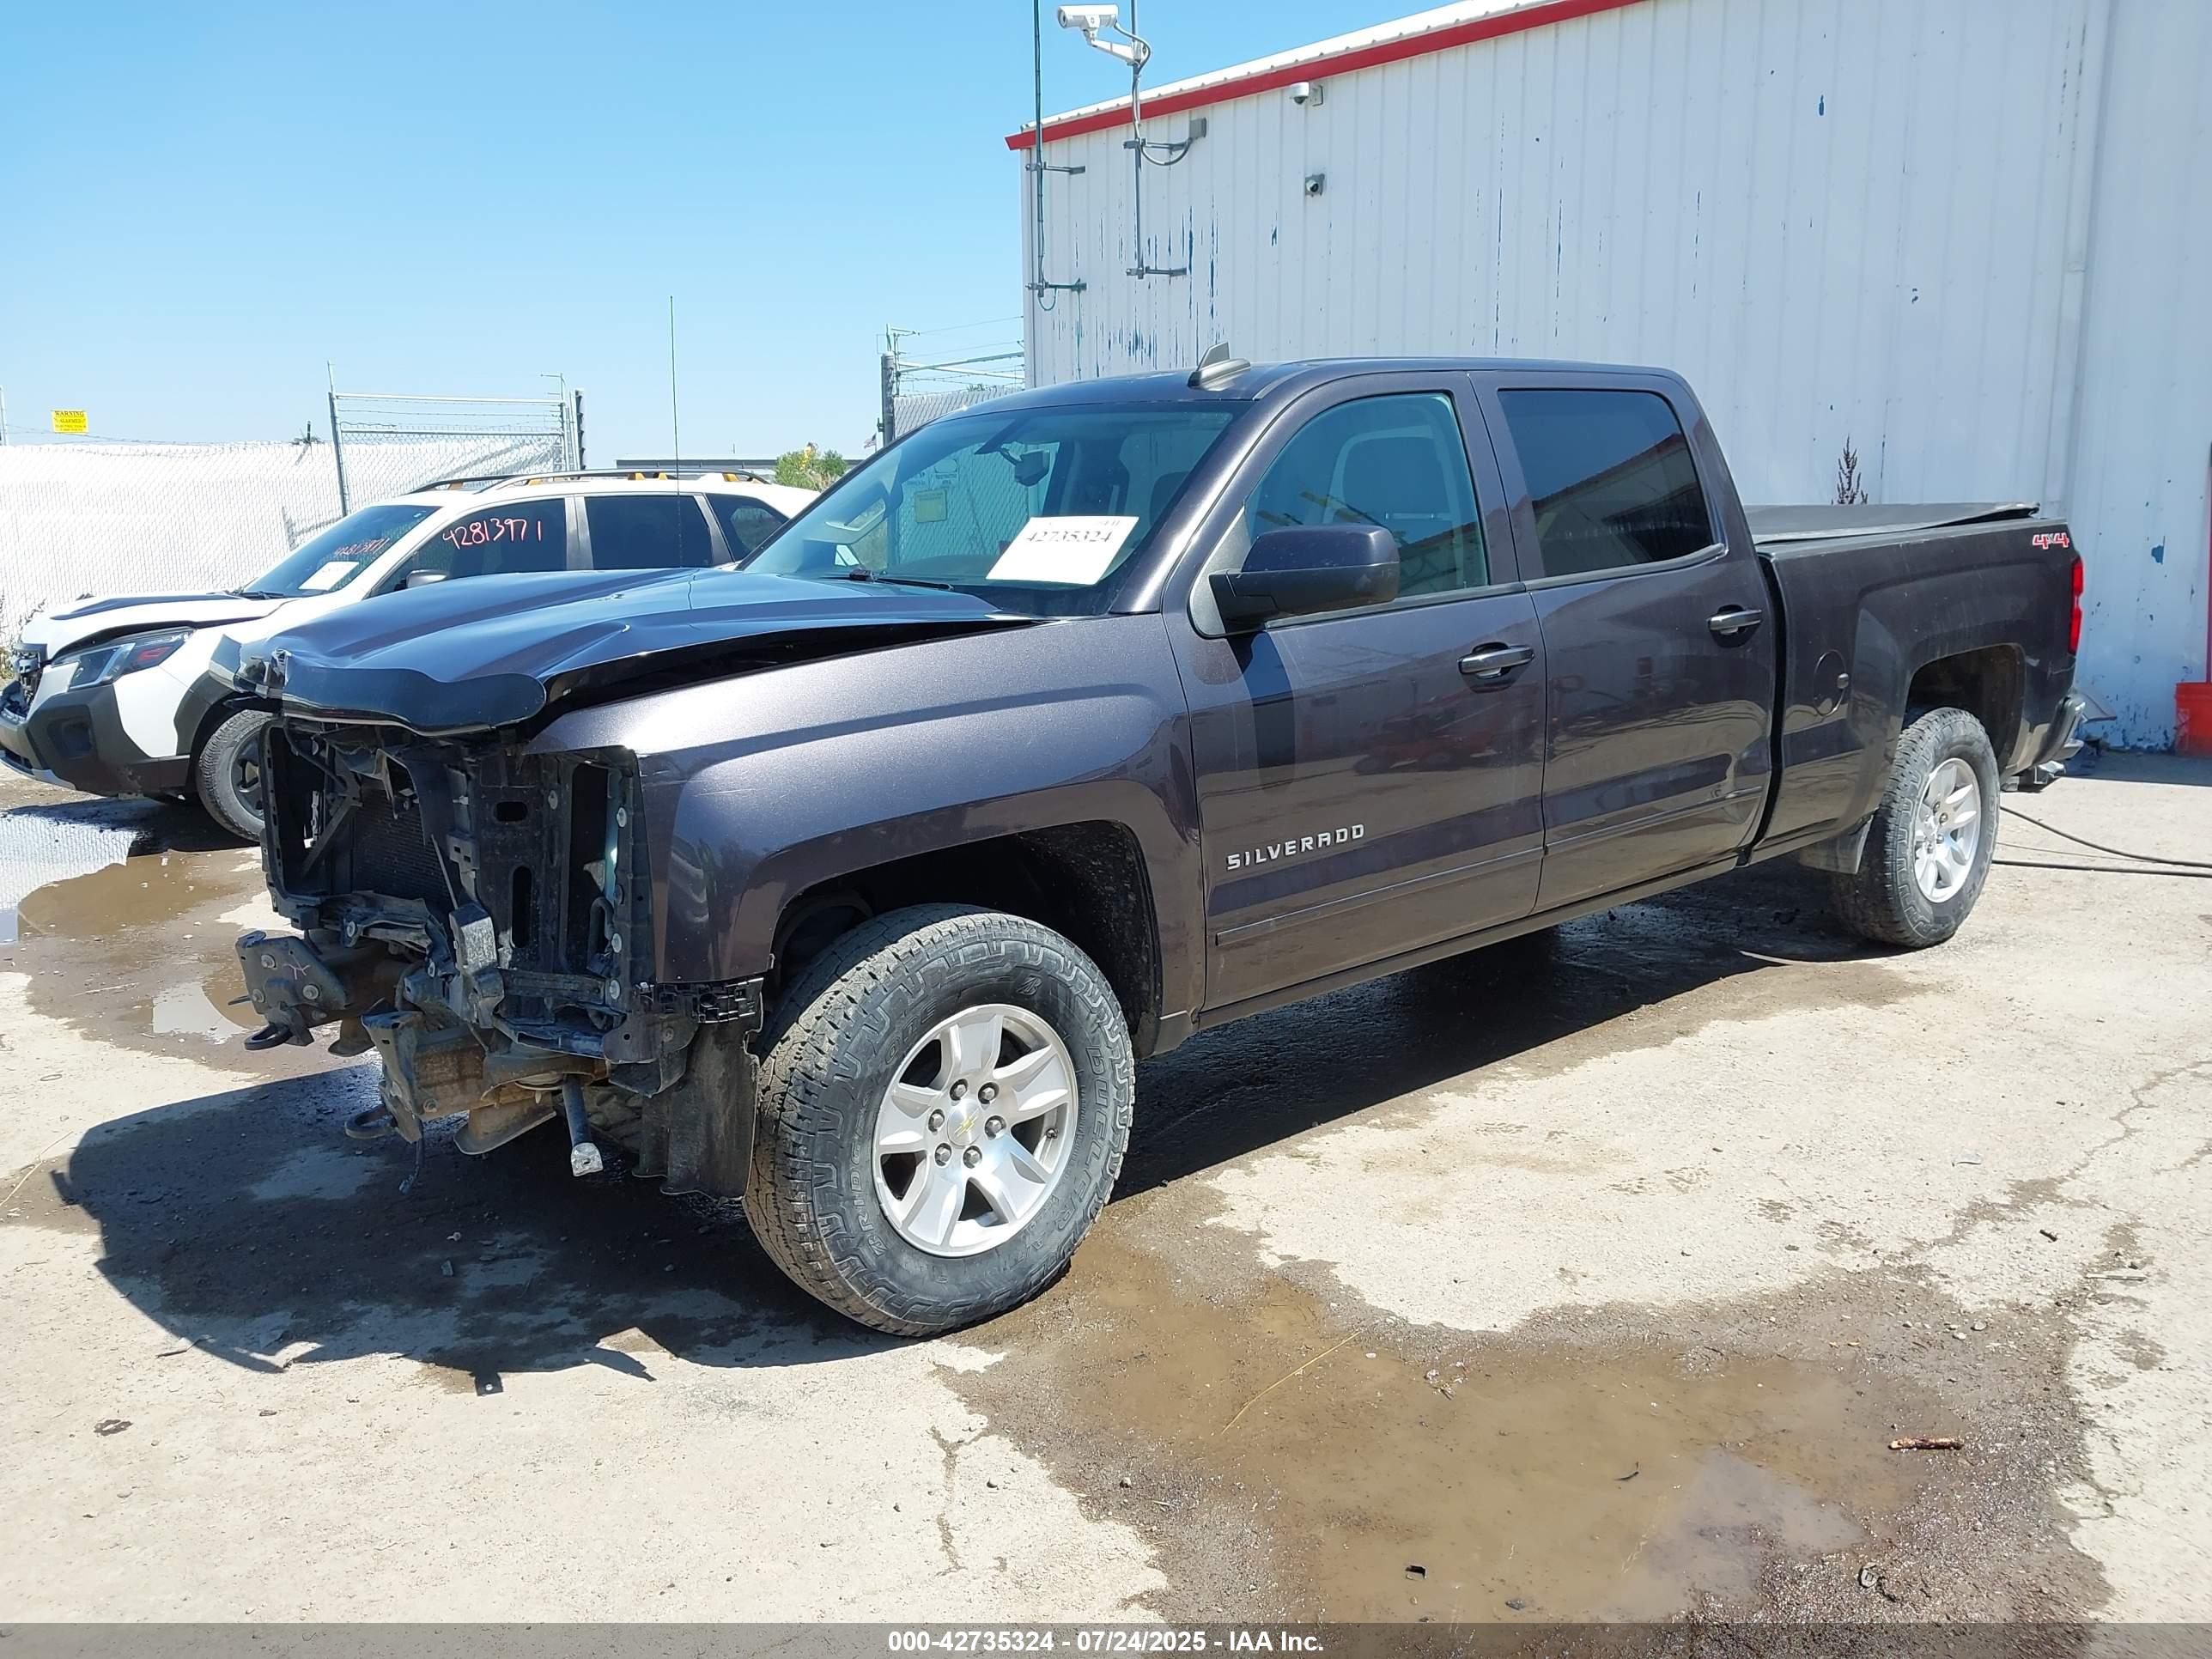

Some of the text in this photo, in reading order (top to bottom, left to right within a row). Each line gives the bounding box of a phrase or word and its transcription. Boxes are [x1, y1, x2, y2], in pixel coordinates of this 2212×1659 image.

[442, 518, 542, 550] 42813971
[1026, 531, 1113, 542] 42735324
[1227, 823, 1364, 871] SILVERADO
